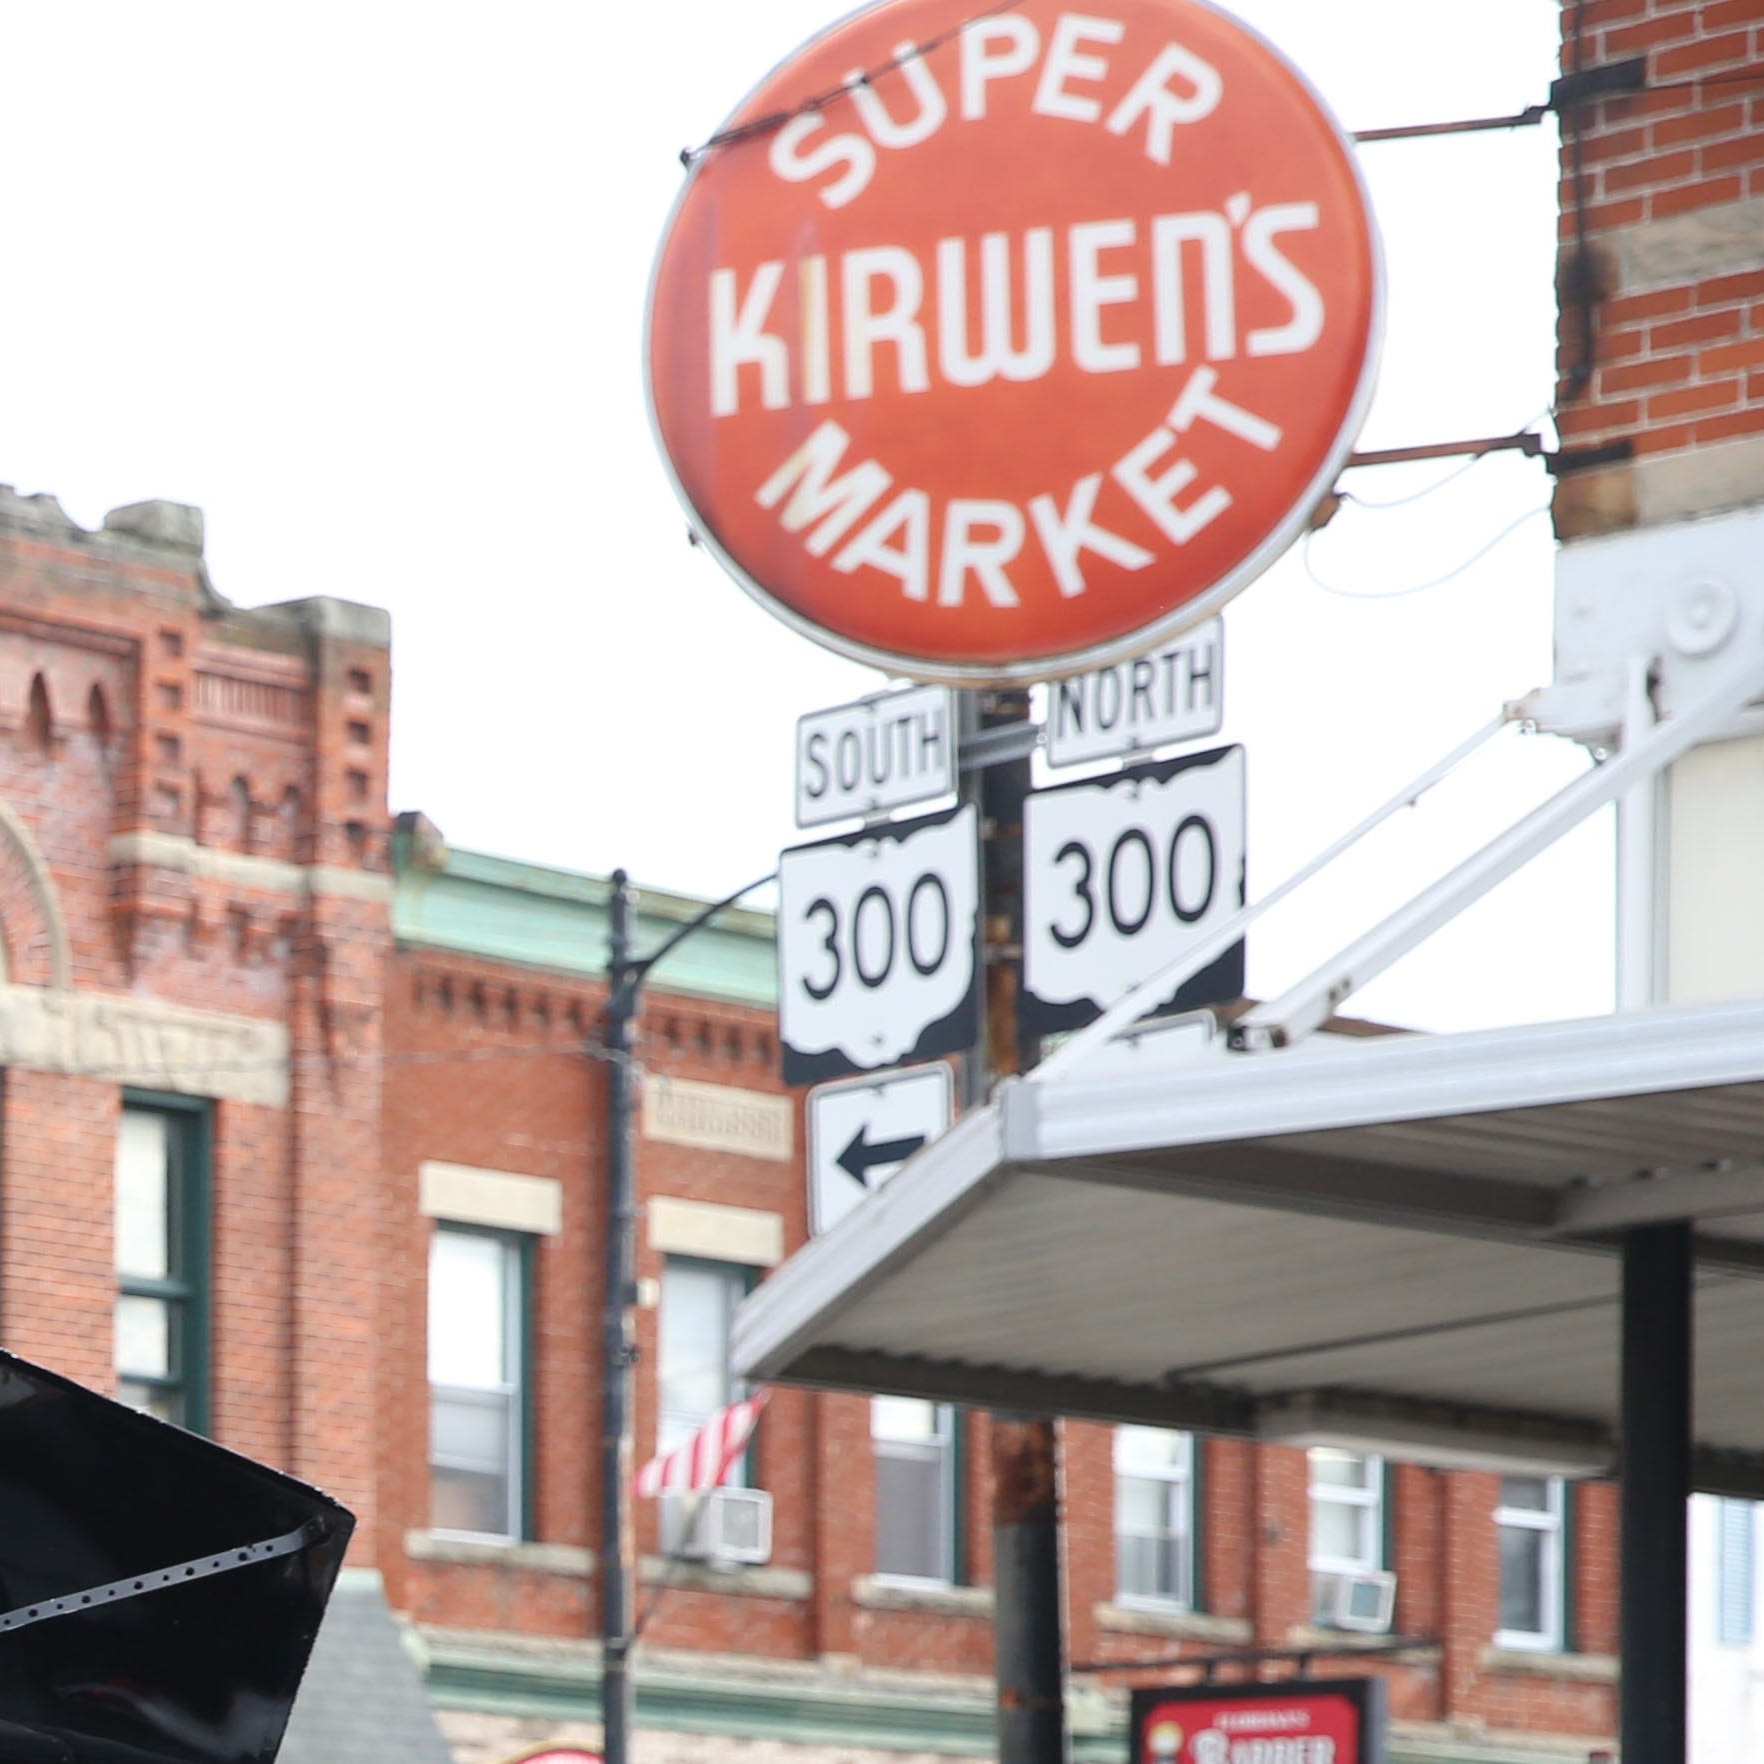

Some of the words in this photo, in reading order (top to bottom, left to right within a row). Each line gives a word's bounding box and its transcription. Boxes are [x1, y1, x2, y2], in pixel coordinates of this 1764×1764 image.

[769, 12, 1224, 210] SUPER
[710, 191, 1325, 417] KIRWEN'S
[755, 364, 1283, 607] MARKET
[805, 711, 946, 799] SOUTH
[1055, 644, 1214, 737] NORTH
[802, 873, 948, 1000] 300
[1051, 814, 1215, 948] 300
